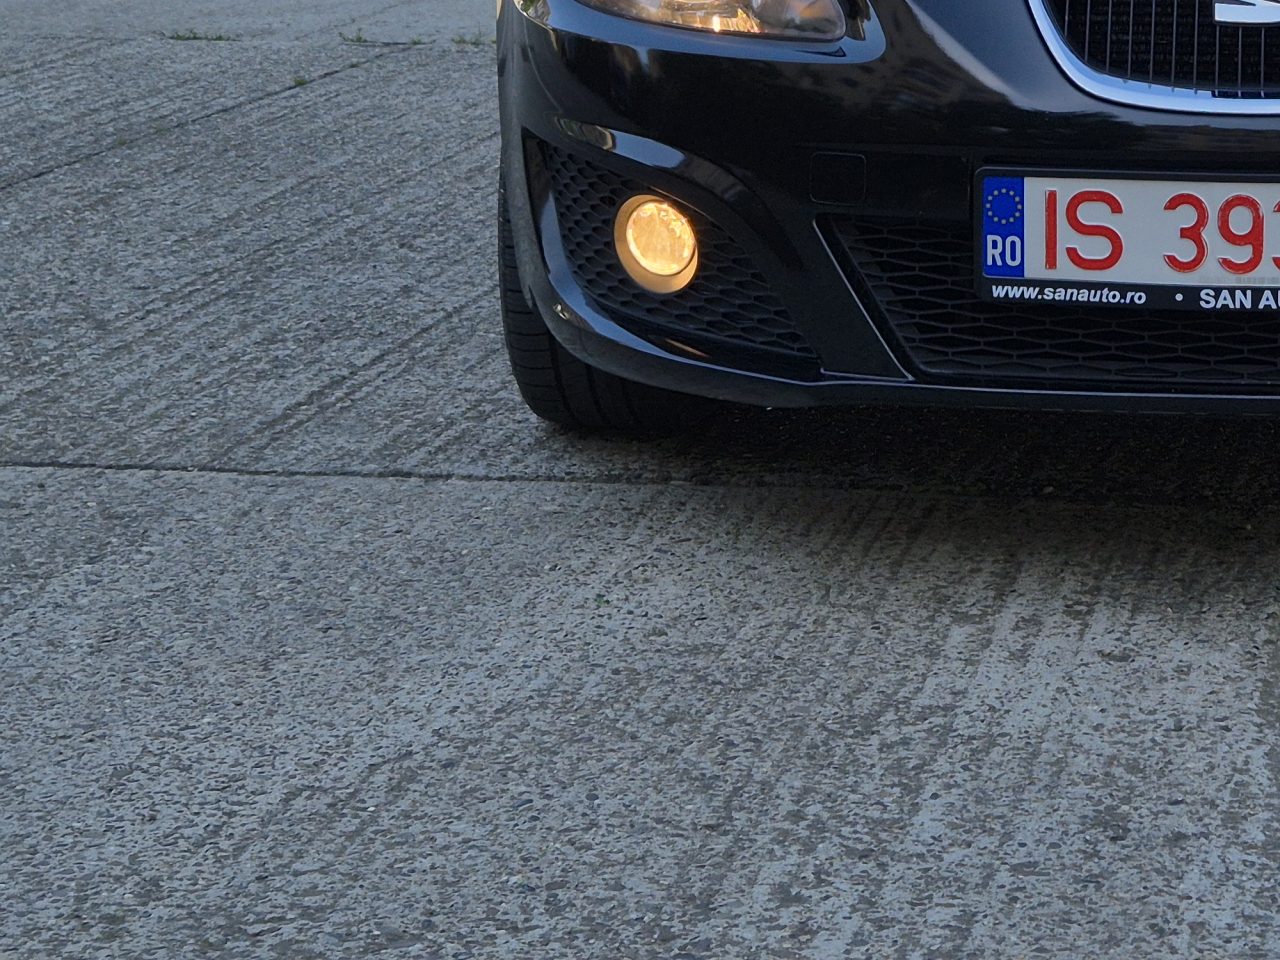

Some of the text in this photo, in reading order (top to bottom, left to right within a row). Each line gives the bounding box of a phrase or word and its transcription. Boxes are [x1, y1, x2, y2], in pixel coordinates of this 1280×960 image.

[1044, 188, 1124, 271] IS
[986, 234, 1022, 267] RO
[991, 284, 1147, 305] www.sanauto.ro
[1199, 288, 1252, 310] SAN
